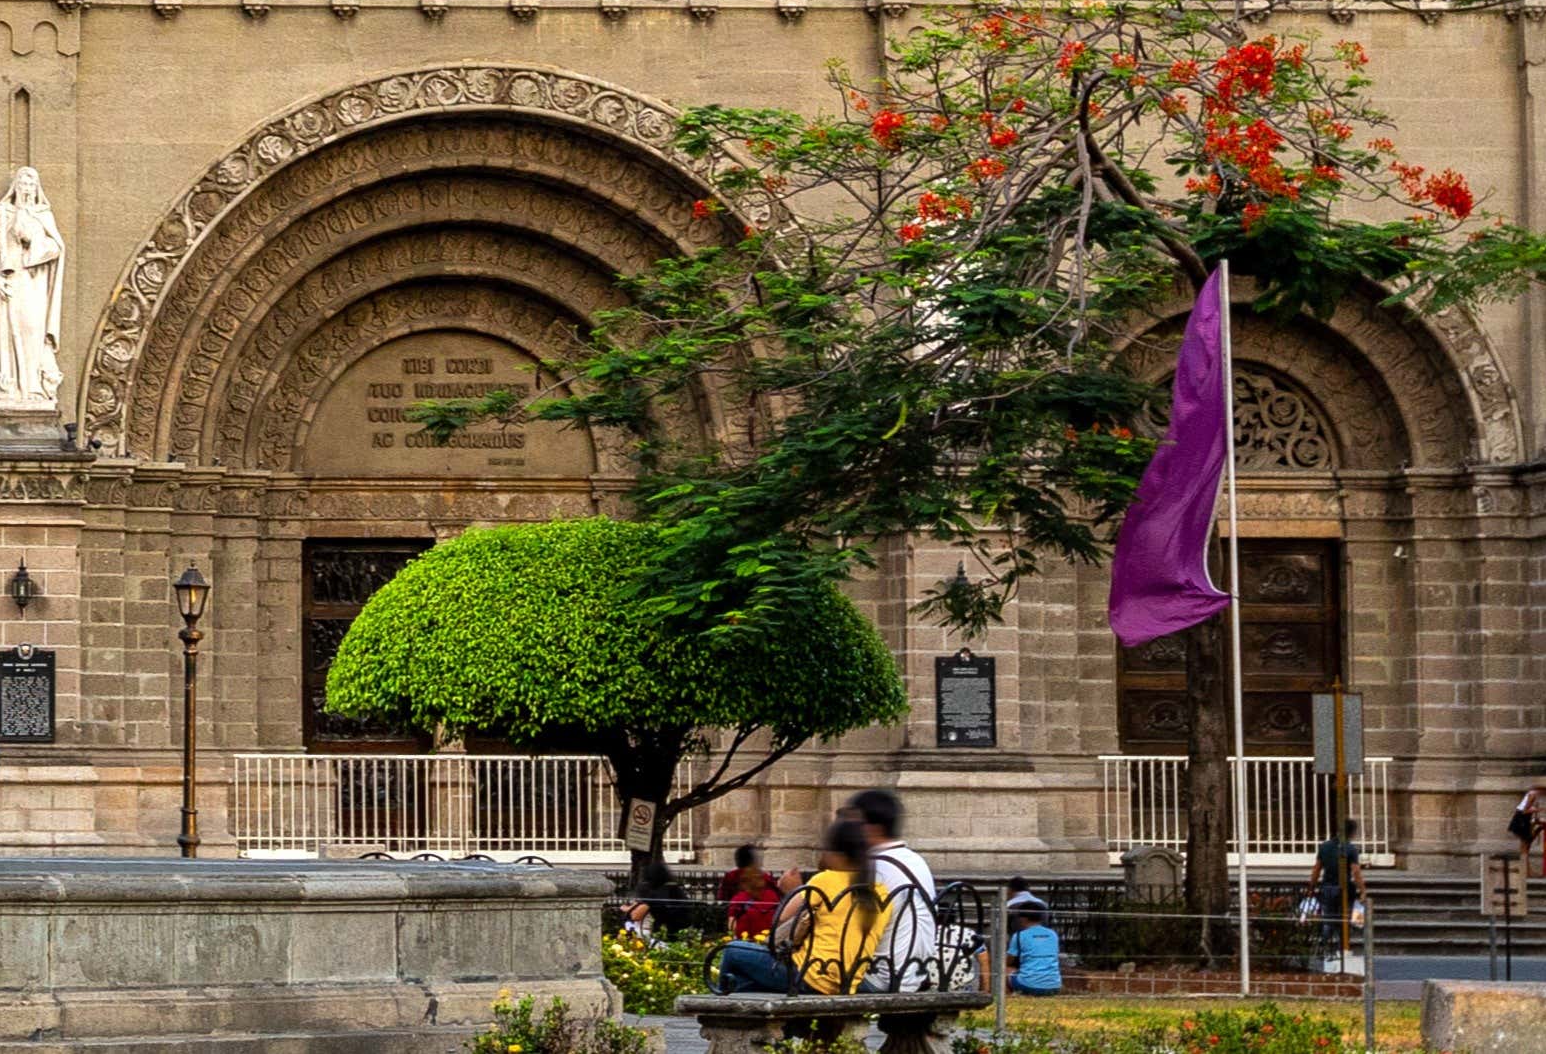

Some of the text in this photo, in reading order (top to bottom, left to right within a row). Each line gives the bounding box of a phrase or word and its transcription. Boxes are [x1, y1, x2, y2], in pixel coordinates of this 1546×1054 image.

[402, 357, 493, 375] TIBI CORDI
[368, 382, 403, 398] TUO
[372, 432, 395, 448] AC
